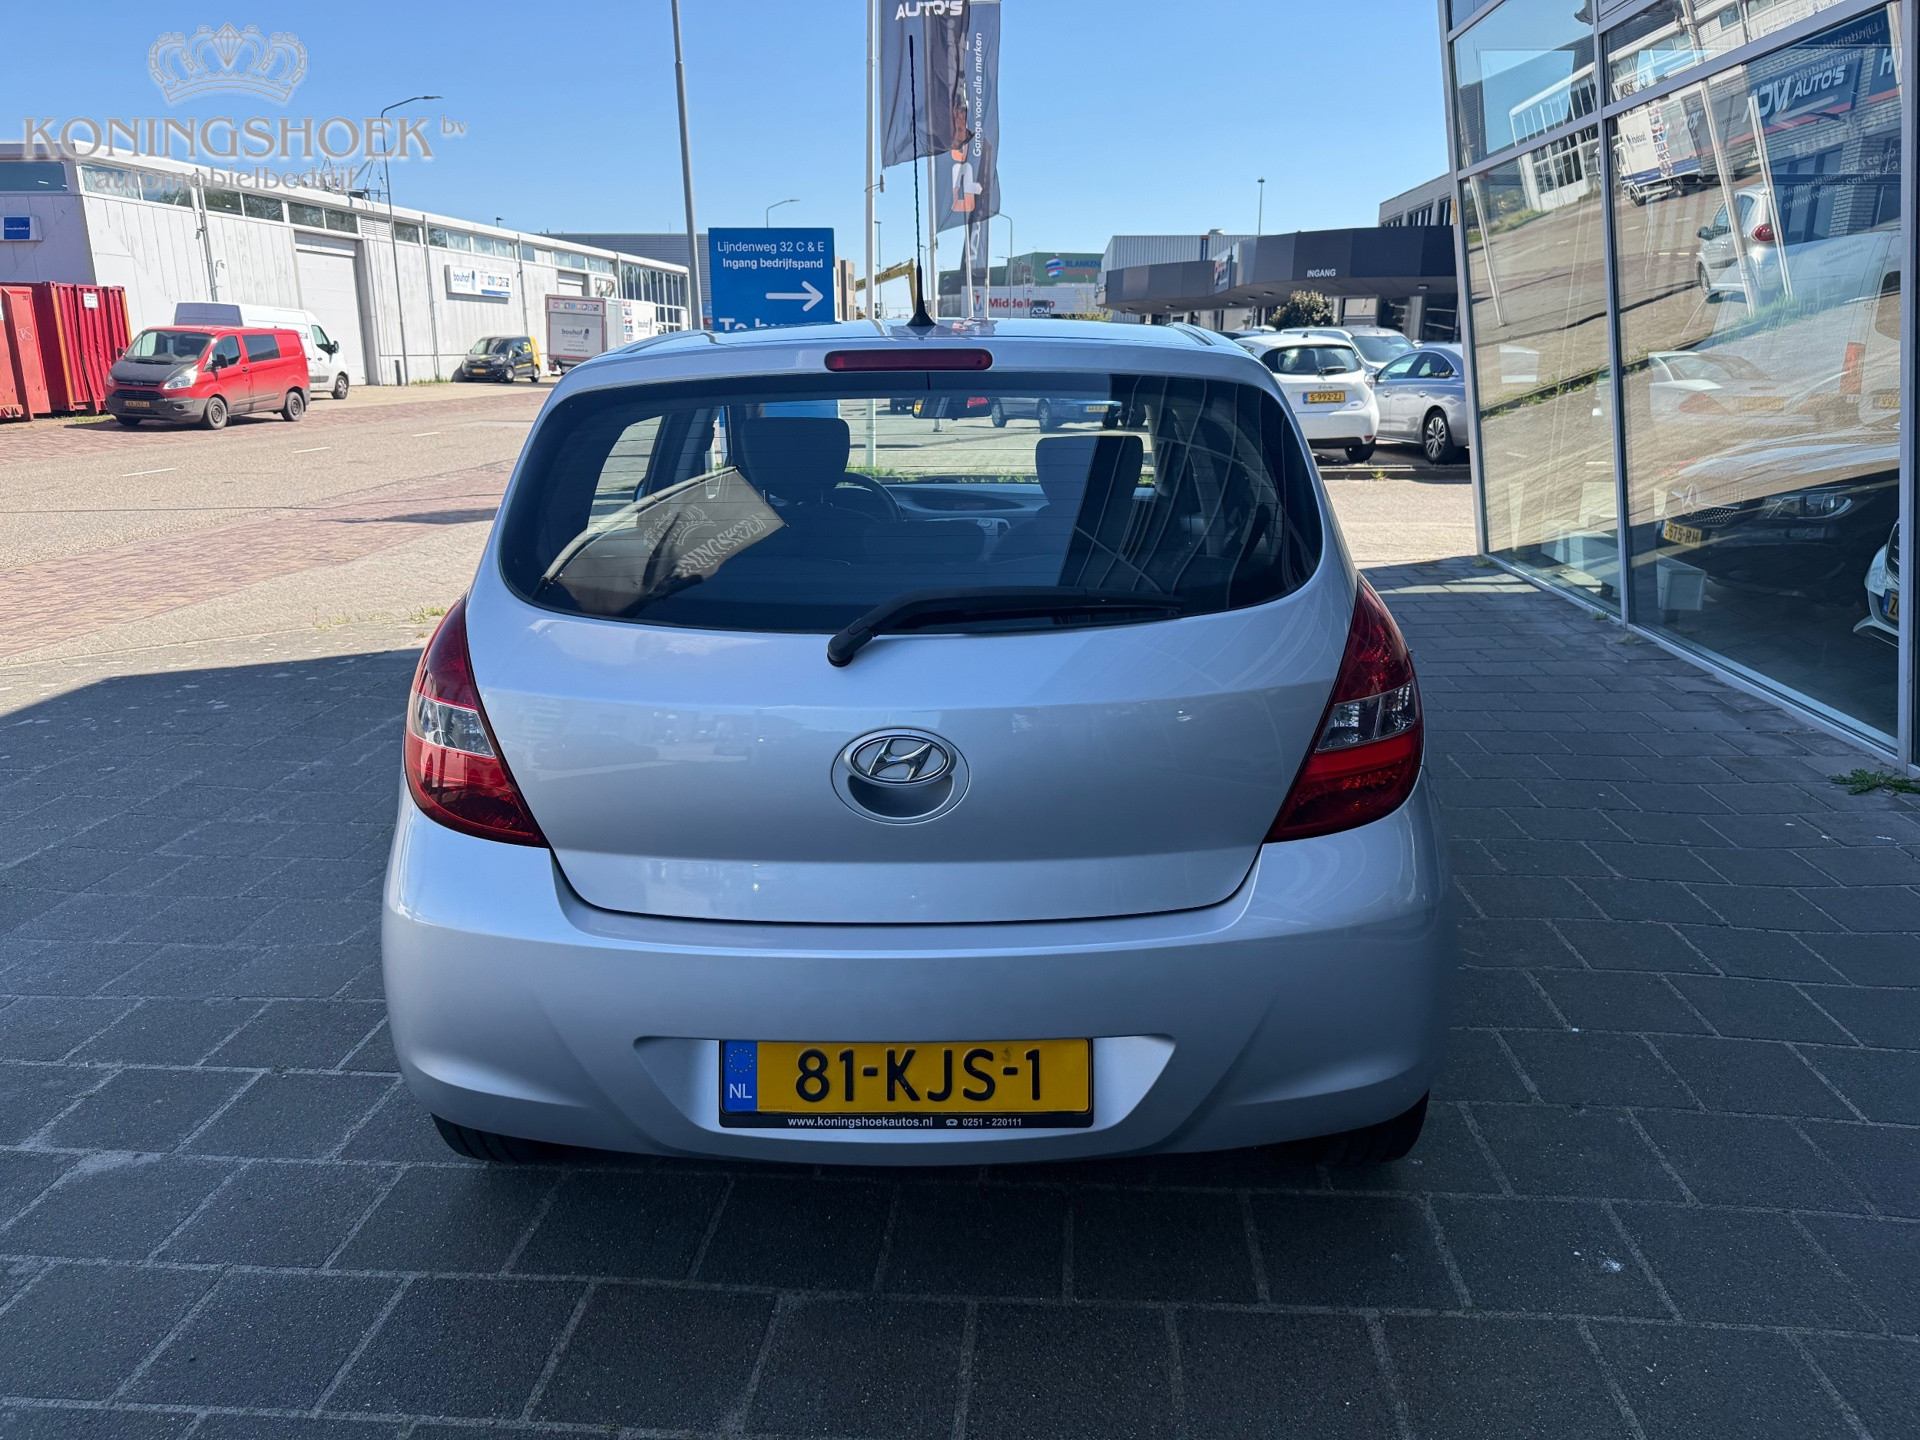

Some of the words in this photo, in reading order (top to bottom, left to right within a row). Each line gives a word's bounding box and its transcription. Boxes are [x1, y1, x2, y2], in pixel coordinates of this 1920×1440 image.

[895, 1, 963, 20] AUTO'S
[973, 32, 982, 73] merken
[973, 75, 982, 95] alle
[1792, 64, 1846, 100] AUTO'S
[972, 120, 983, 157] Garage
[717, 241, 777, 254] Lijndenweg
[779, 241, 793, 252] 32
[796, 241, 804, 252] C
[807, 241, 815, 252] &
[818, 241, 825, 252] E
[723, 258, 757, 270] Ingang
[760, 258, 824, 270] bedrijfspand
[1306, 268, 1337, 278] INGANG
[796, 1048, 1041, 1102] 81-KJS-1
[729, 1083, 752, 1099] NL
[787, 1116, 933, 1128] www.koningshoekautos.nl
[962, 1118, 983, 1127] 0251
[991, 1118, 1022, 1127] 220111
